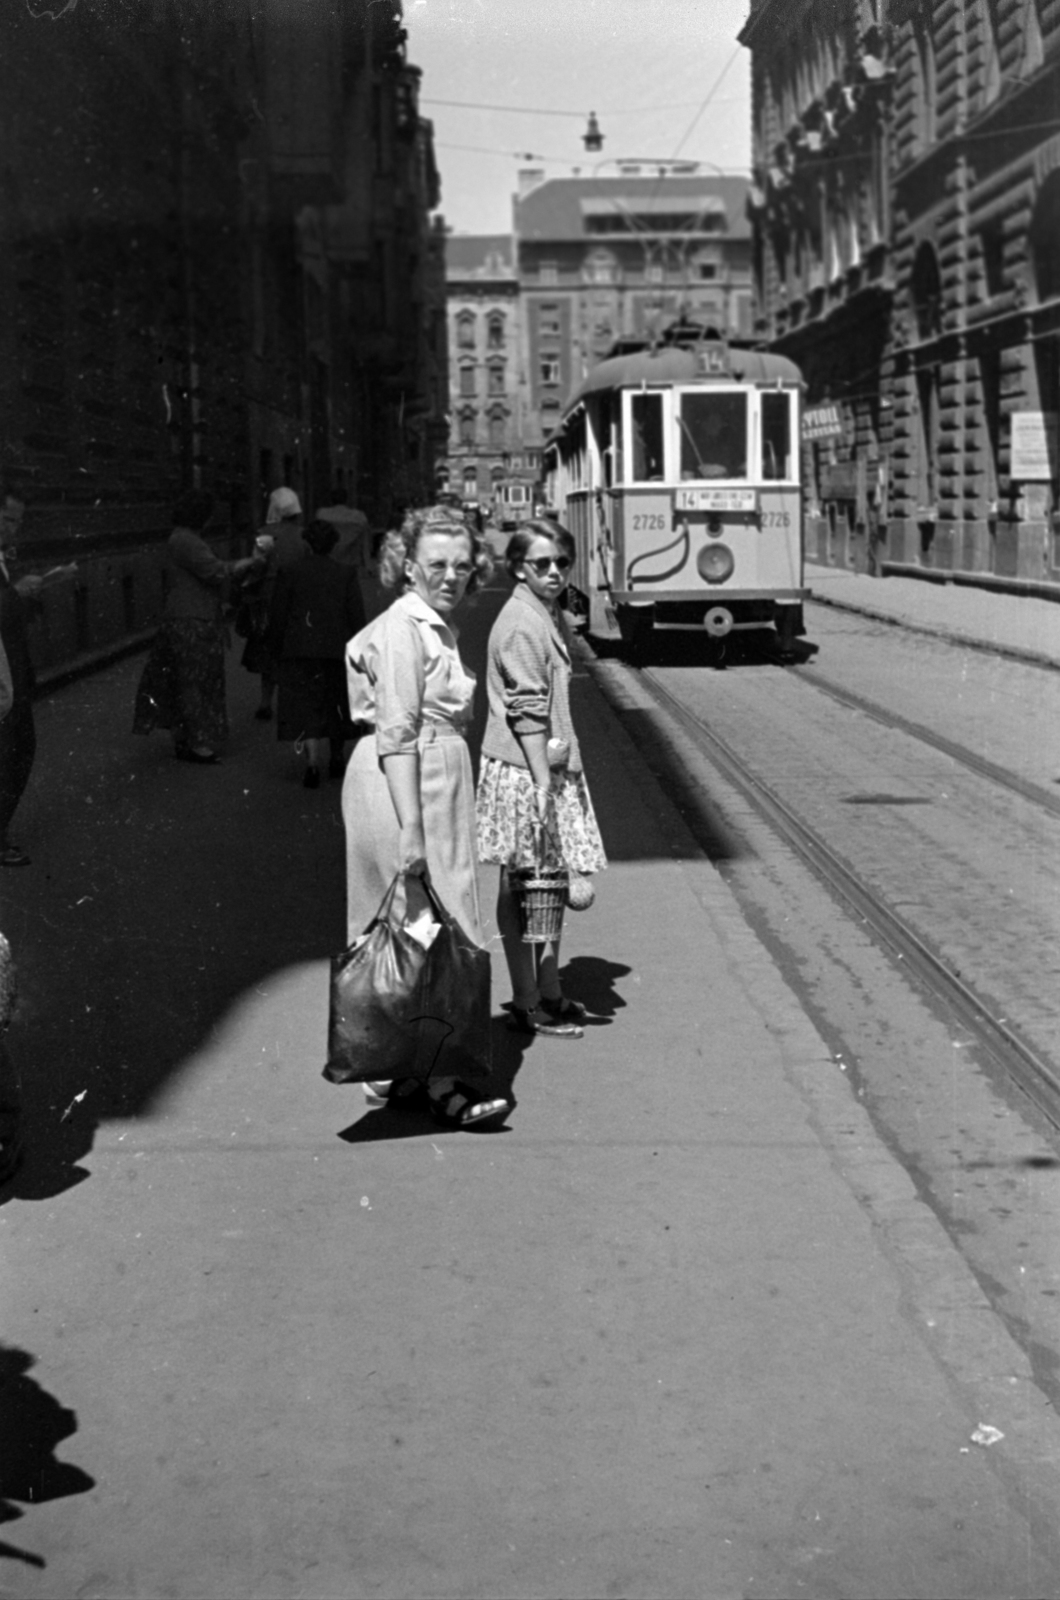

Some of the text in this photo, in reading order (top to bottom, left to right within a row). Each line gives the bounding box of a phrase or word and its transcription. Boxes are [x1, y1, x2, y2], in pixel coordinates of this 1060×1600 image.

[700, 351, 723, 373] 14
[682, 492, 695, 508] 14
[632, 514, 665, 530] 2726
[761, 511, 791, 528] 2726
